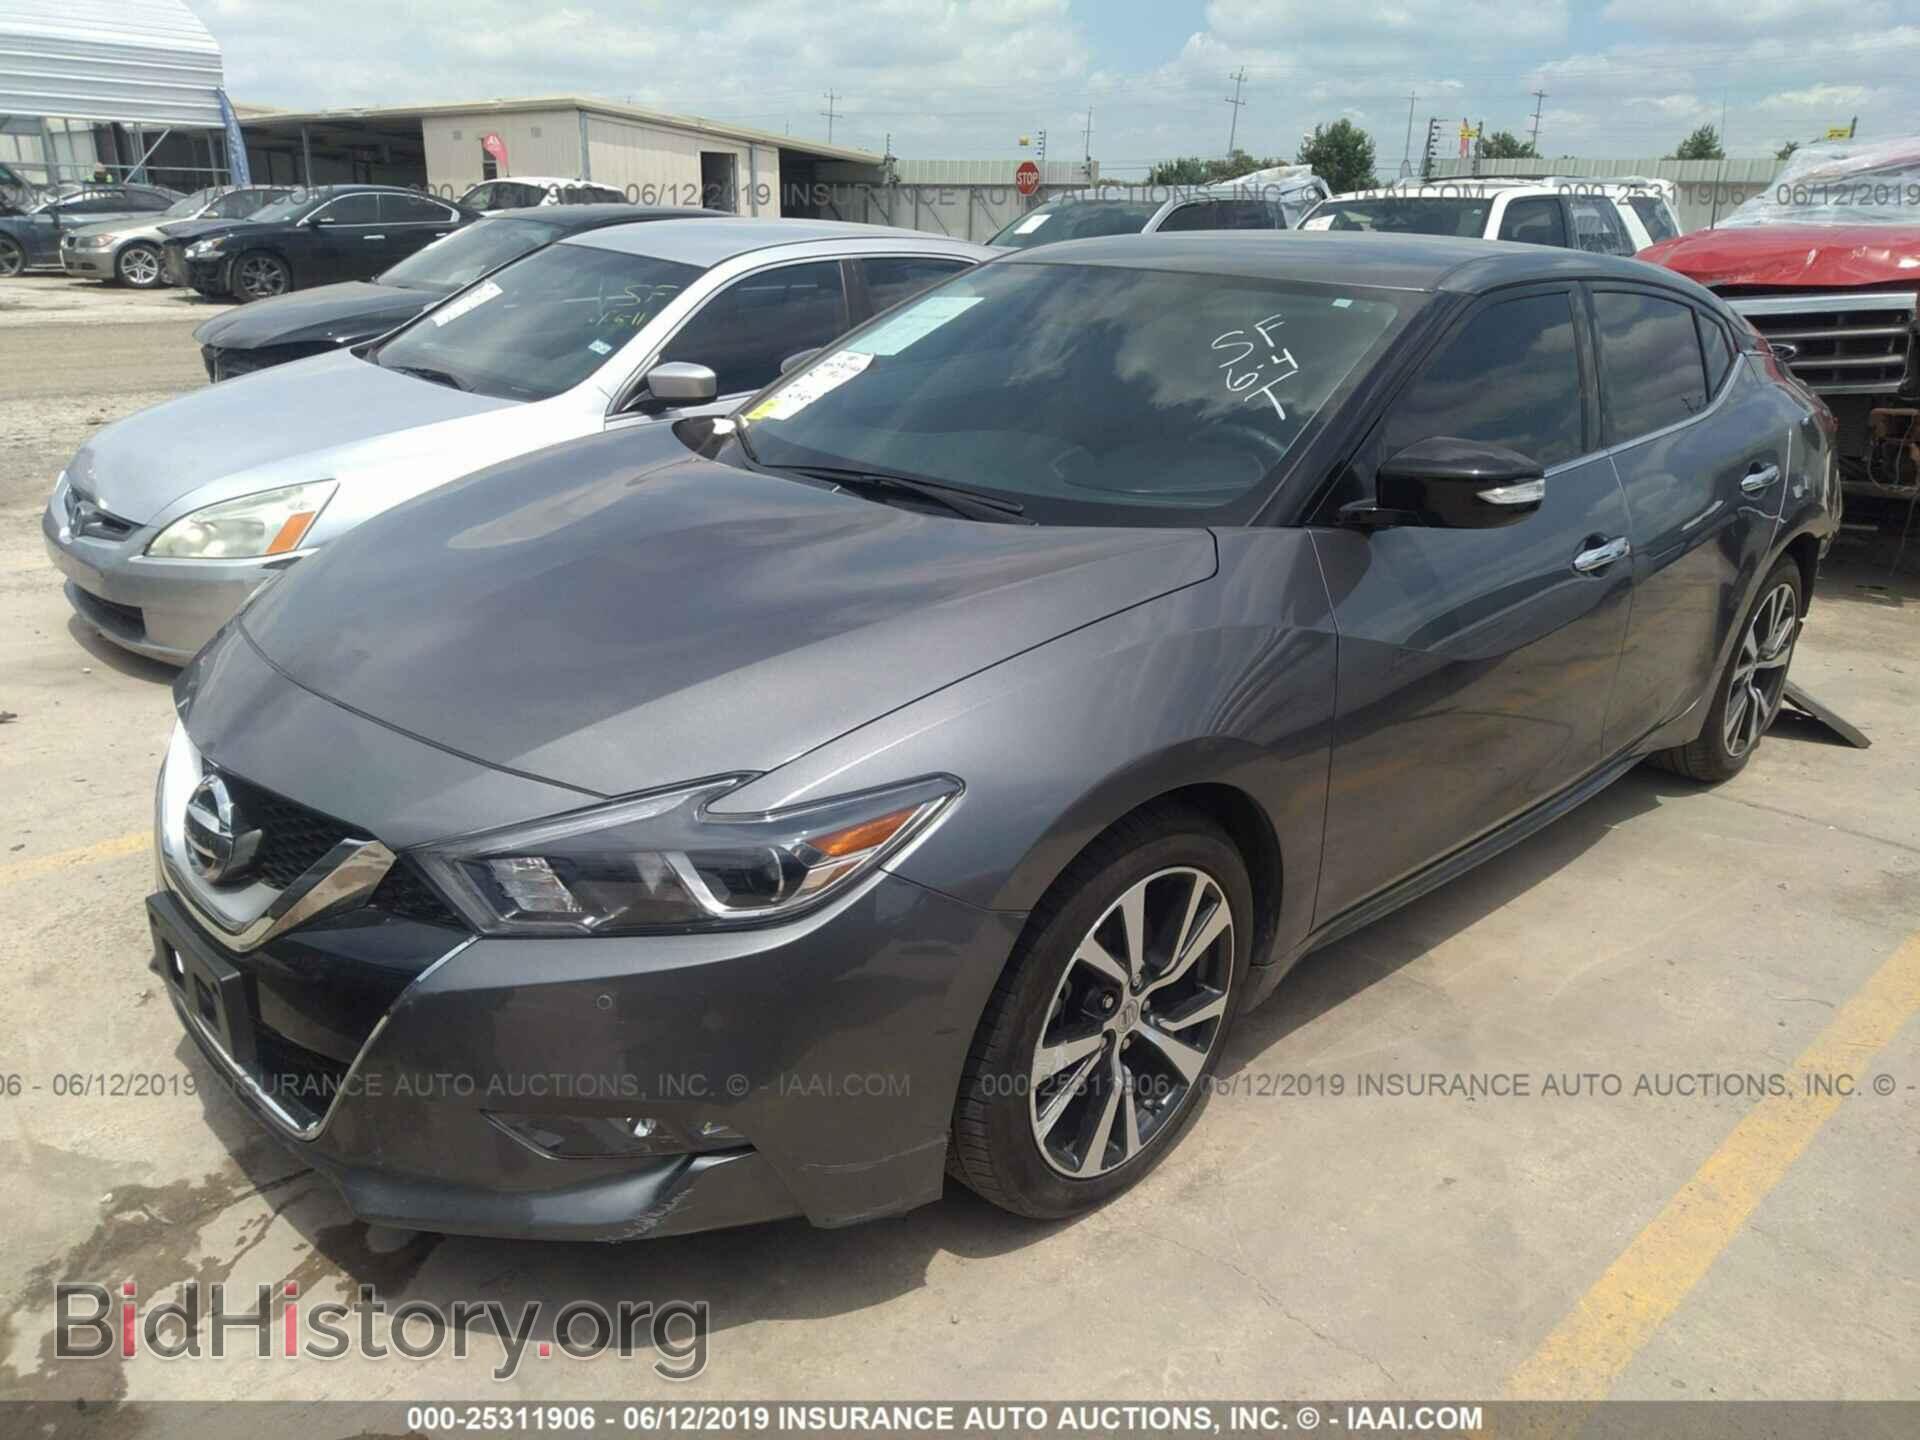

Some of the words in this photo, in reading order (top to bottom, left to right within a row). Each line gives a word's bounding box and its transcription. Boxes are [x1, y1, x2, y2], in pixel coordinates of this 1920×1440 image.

[1016, 171, 1038, 185] STOP
[1211, 313, 1285, 369] SF
[1226, 347, 1299, 392] 6-4
